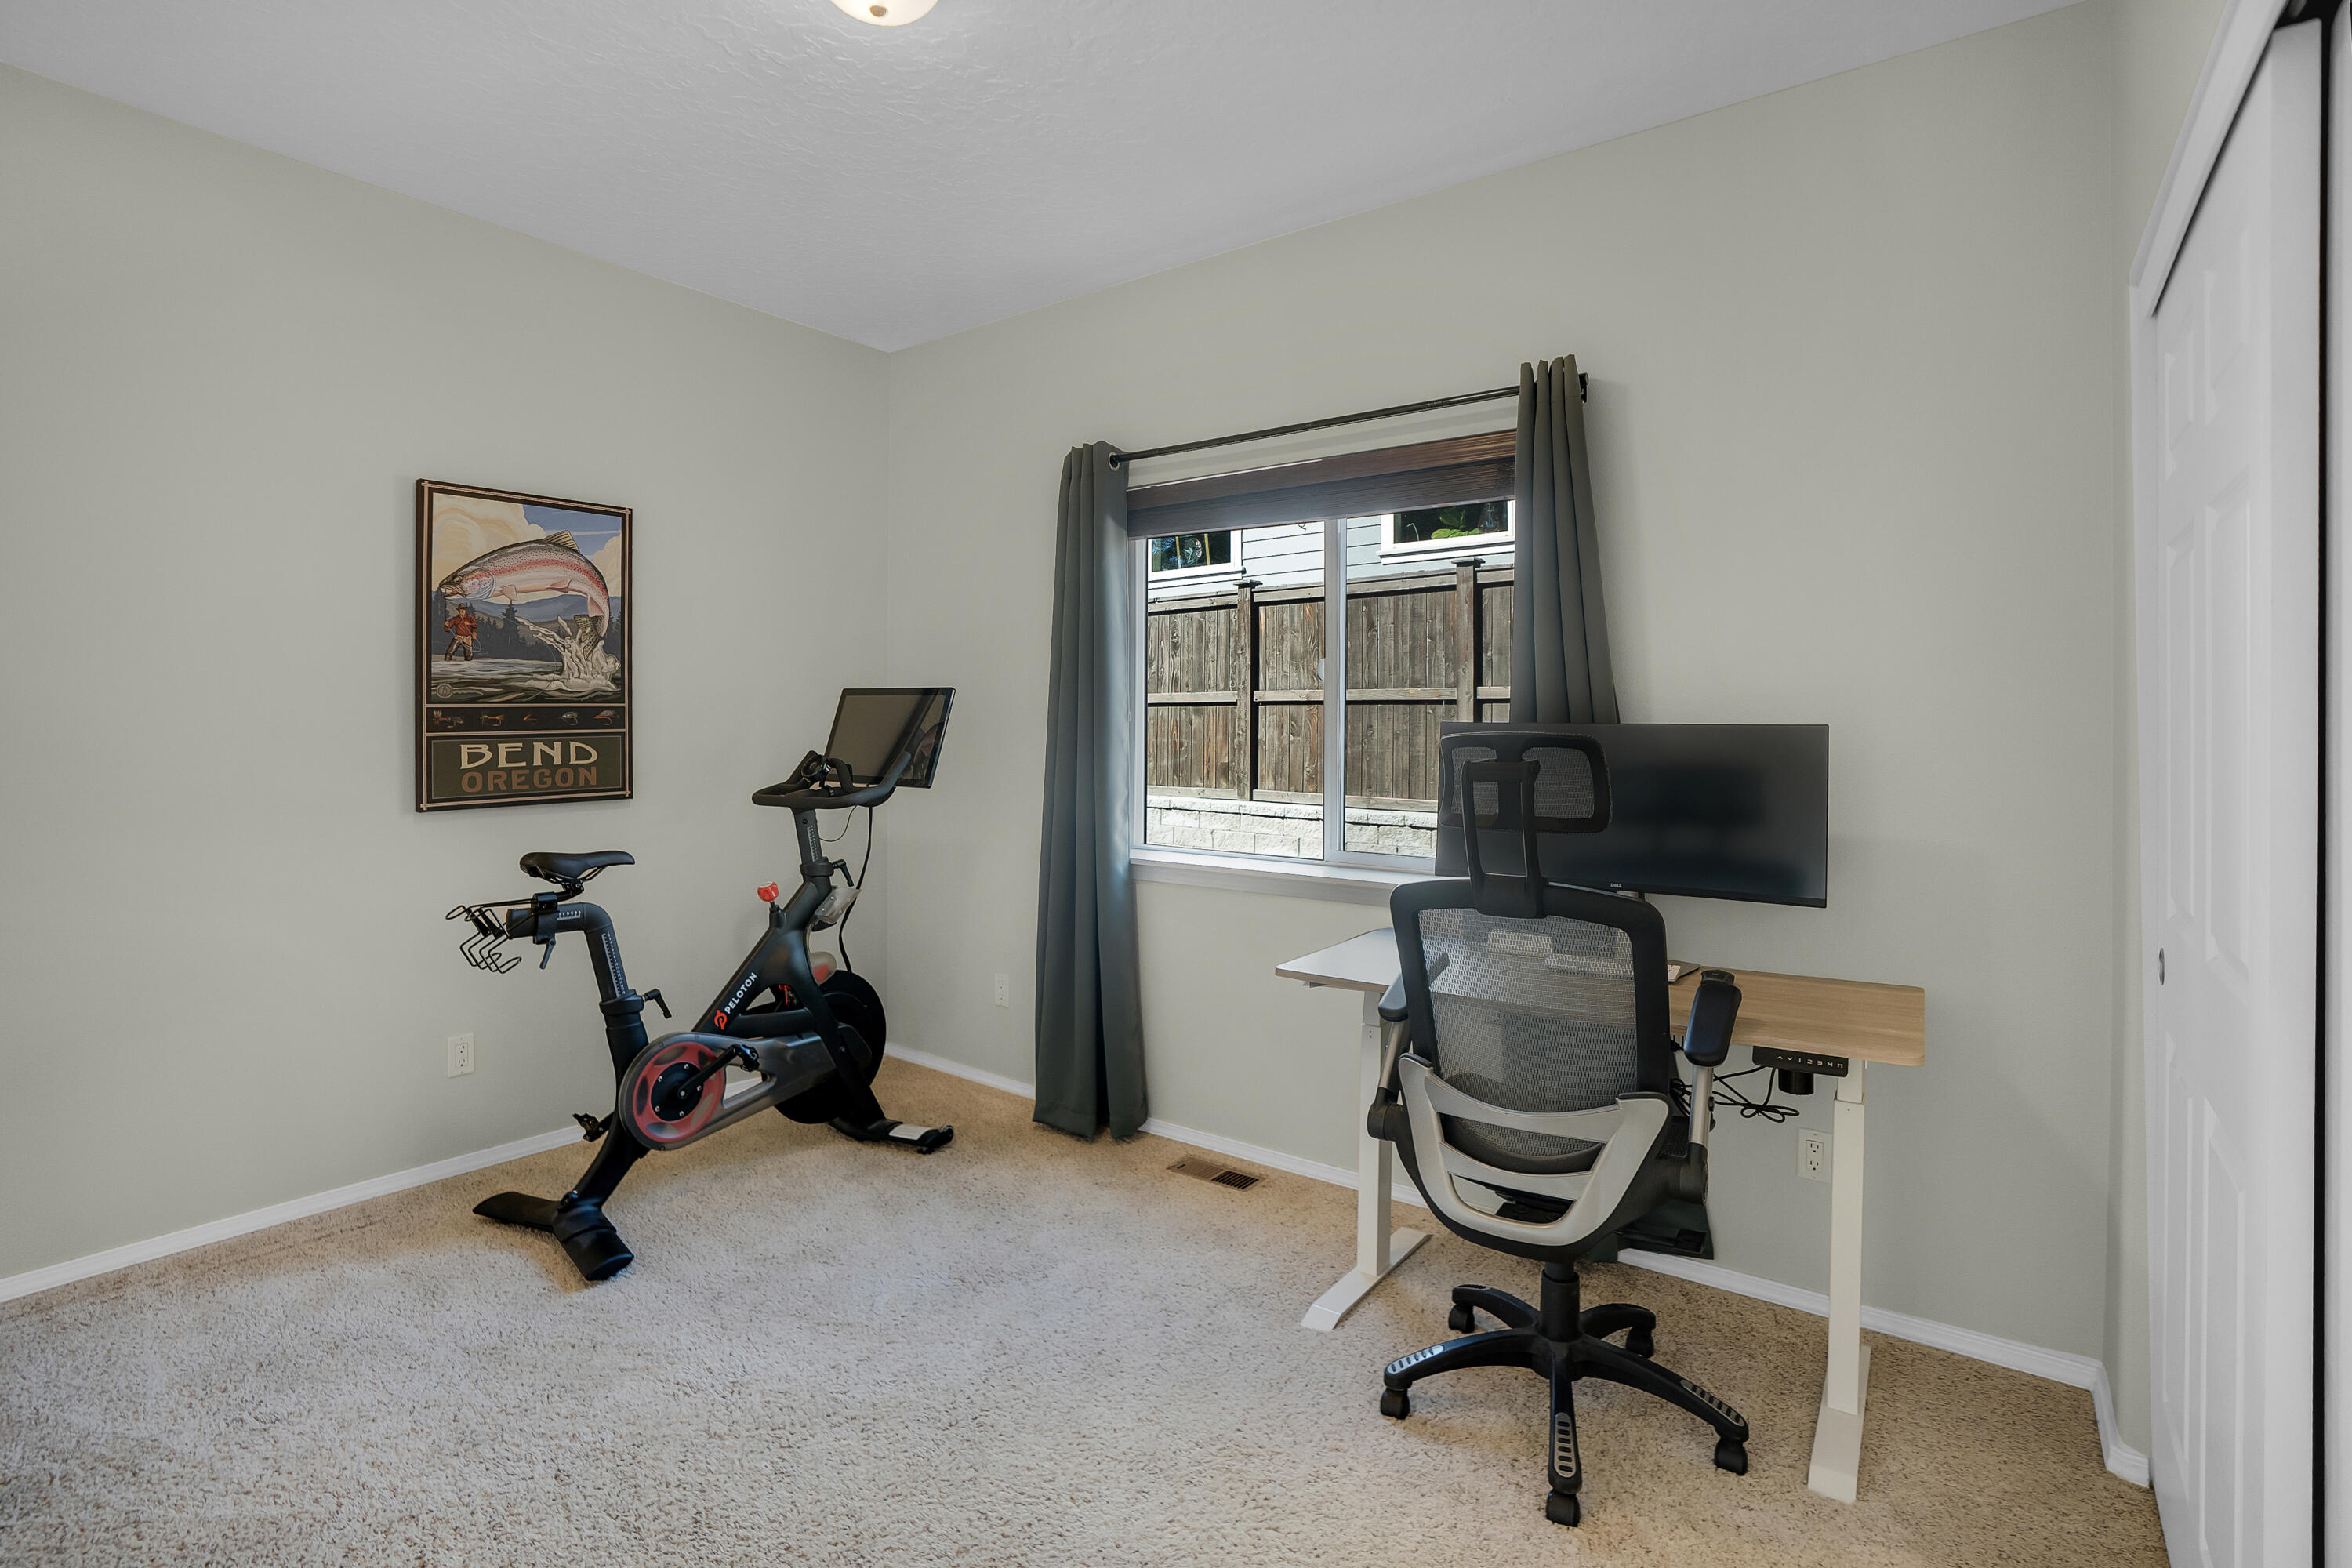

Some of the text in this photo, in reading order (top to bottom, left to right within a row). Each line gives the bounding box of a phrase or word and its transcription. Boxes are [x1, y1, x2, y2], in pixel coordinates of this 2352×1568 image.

[459, 741, 598, 770] BEND
[461, 766, 597, 793] OREGON
[724, 972, 757, 1014] PELOTON
